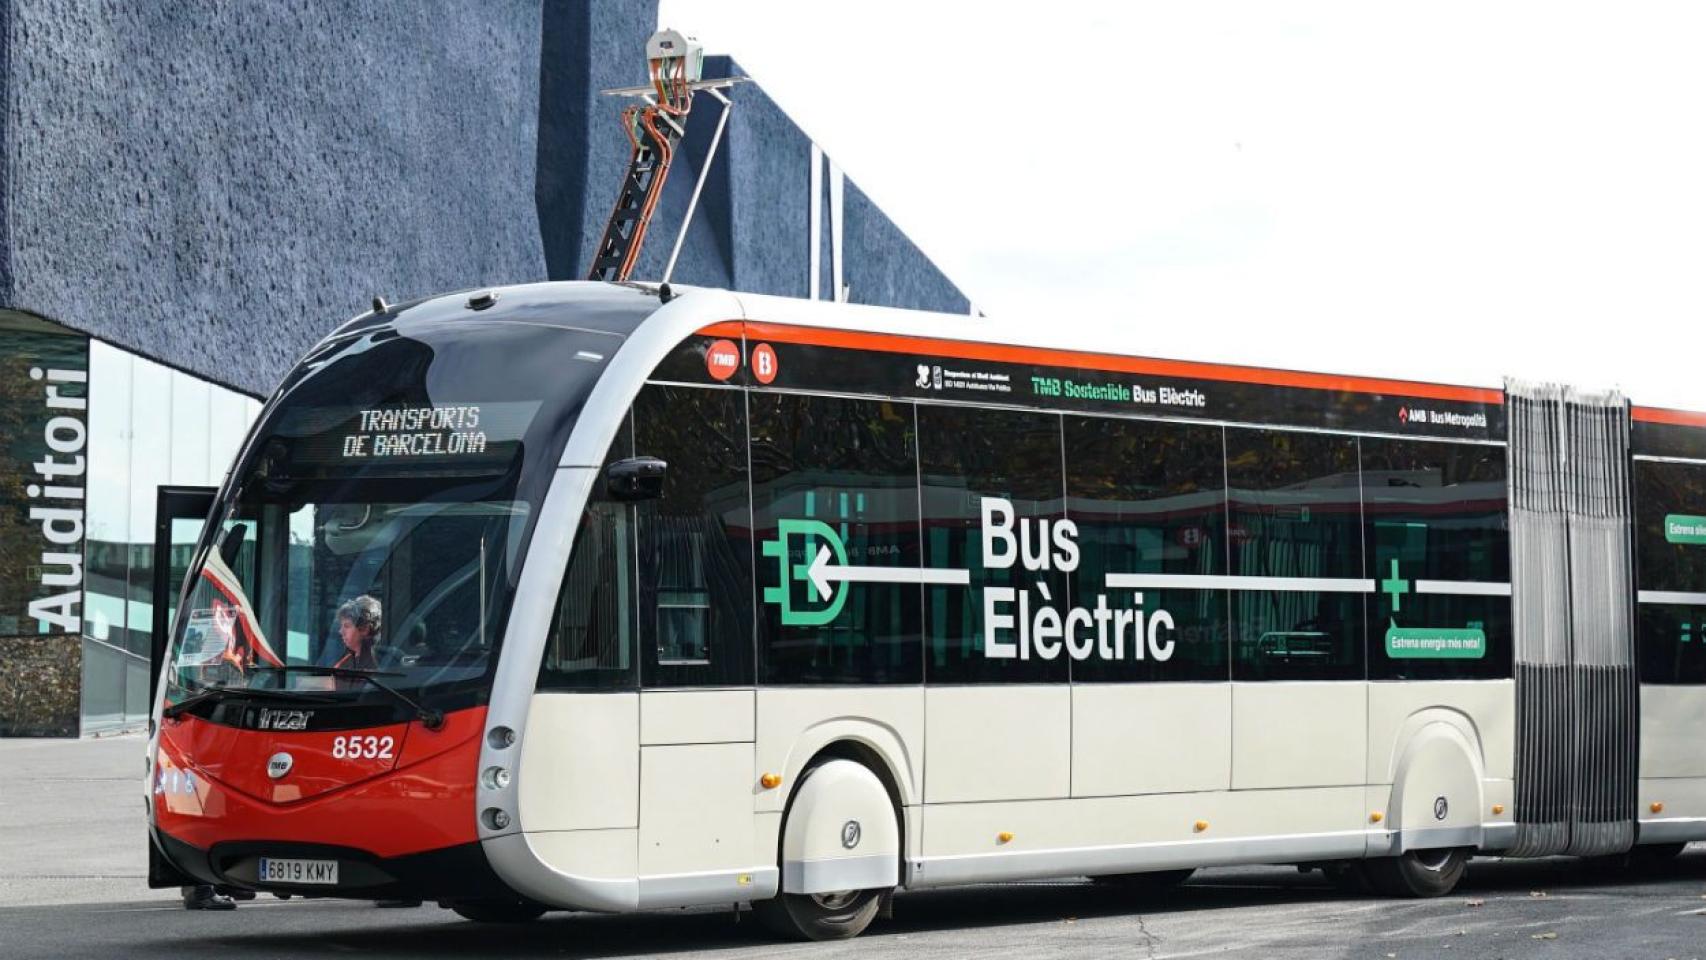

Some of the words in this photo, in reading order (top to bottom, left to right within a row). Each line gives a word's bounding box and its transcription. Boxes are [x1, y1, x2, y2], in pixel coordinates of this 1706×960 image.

[713, 352, 737, 367] TMB
[1031, 376, 1062, 397] TMB
[1064, 380, 1130, 402] Sostenible
[1132, 384, 1157, 405] Bus
[1159, 386, 1206, 408] Elèctric
[359, 406, 481, 432] TRANSPORTS
[1408, 408, 1427, 423] AMB
[1430, 410, 1444, 425] Bus
[343, 434, 371, 457] DE
[373, 431, 487, 457] BARCELONA
[26, 366, 88, 634] Auditori
[981, 496, 1081, 573] Bus
[982, 581, 1176, 662] Elèctric
[332, 735, 394, 759] 8532
[268, 861, 302, 880] 6819
[306, 862, 334, 881] KMY
